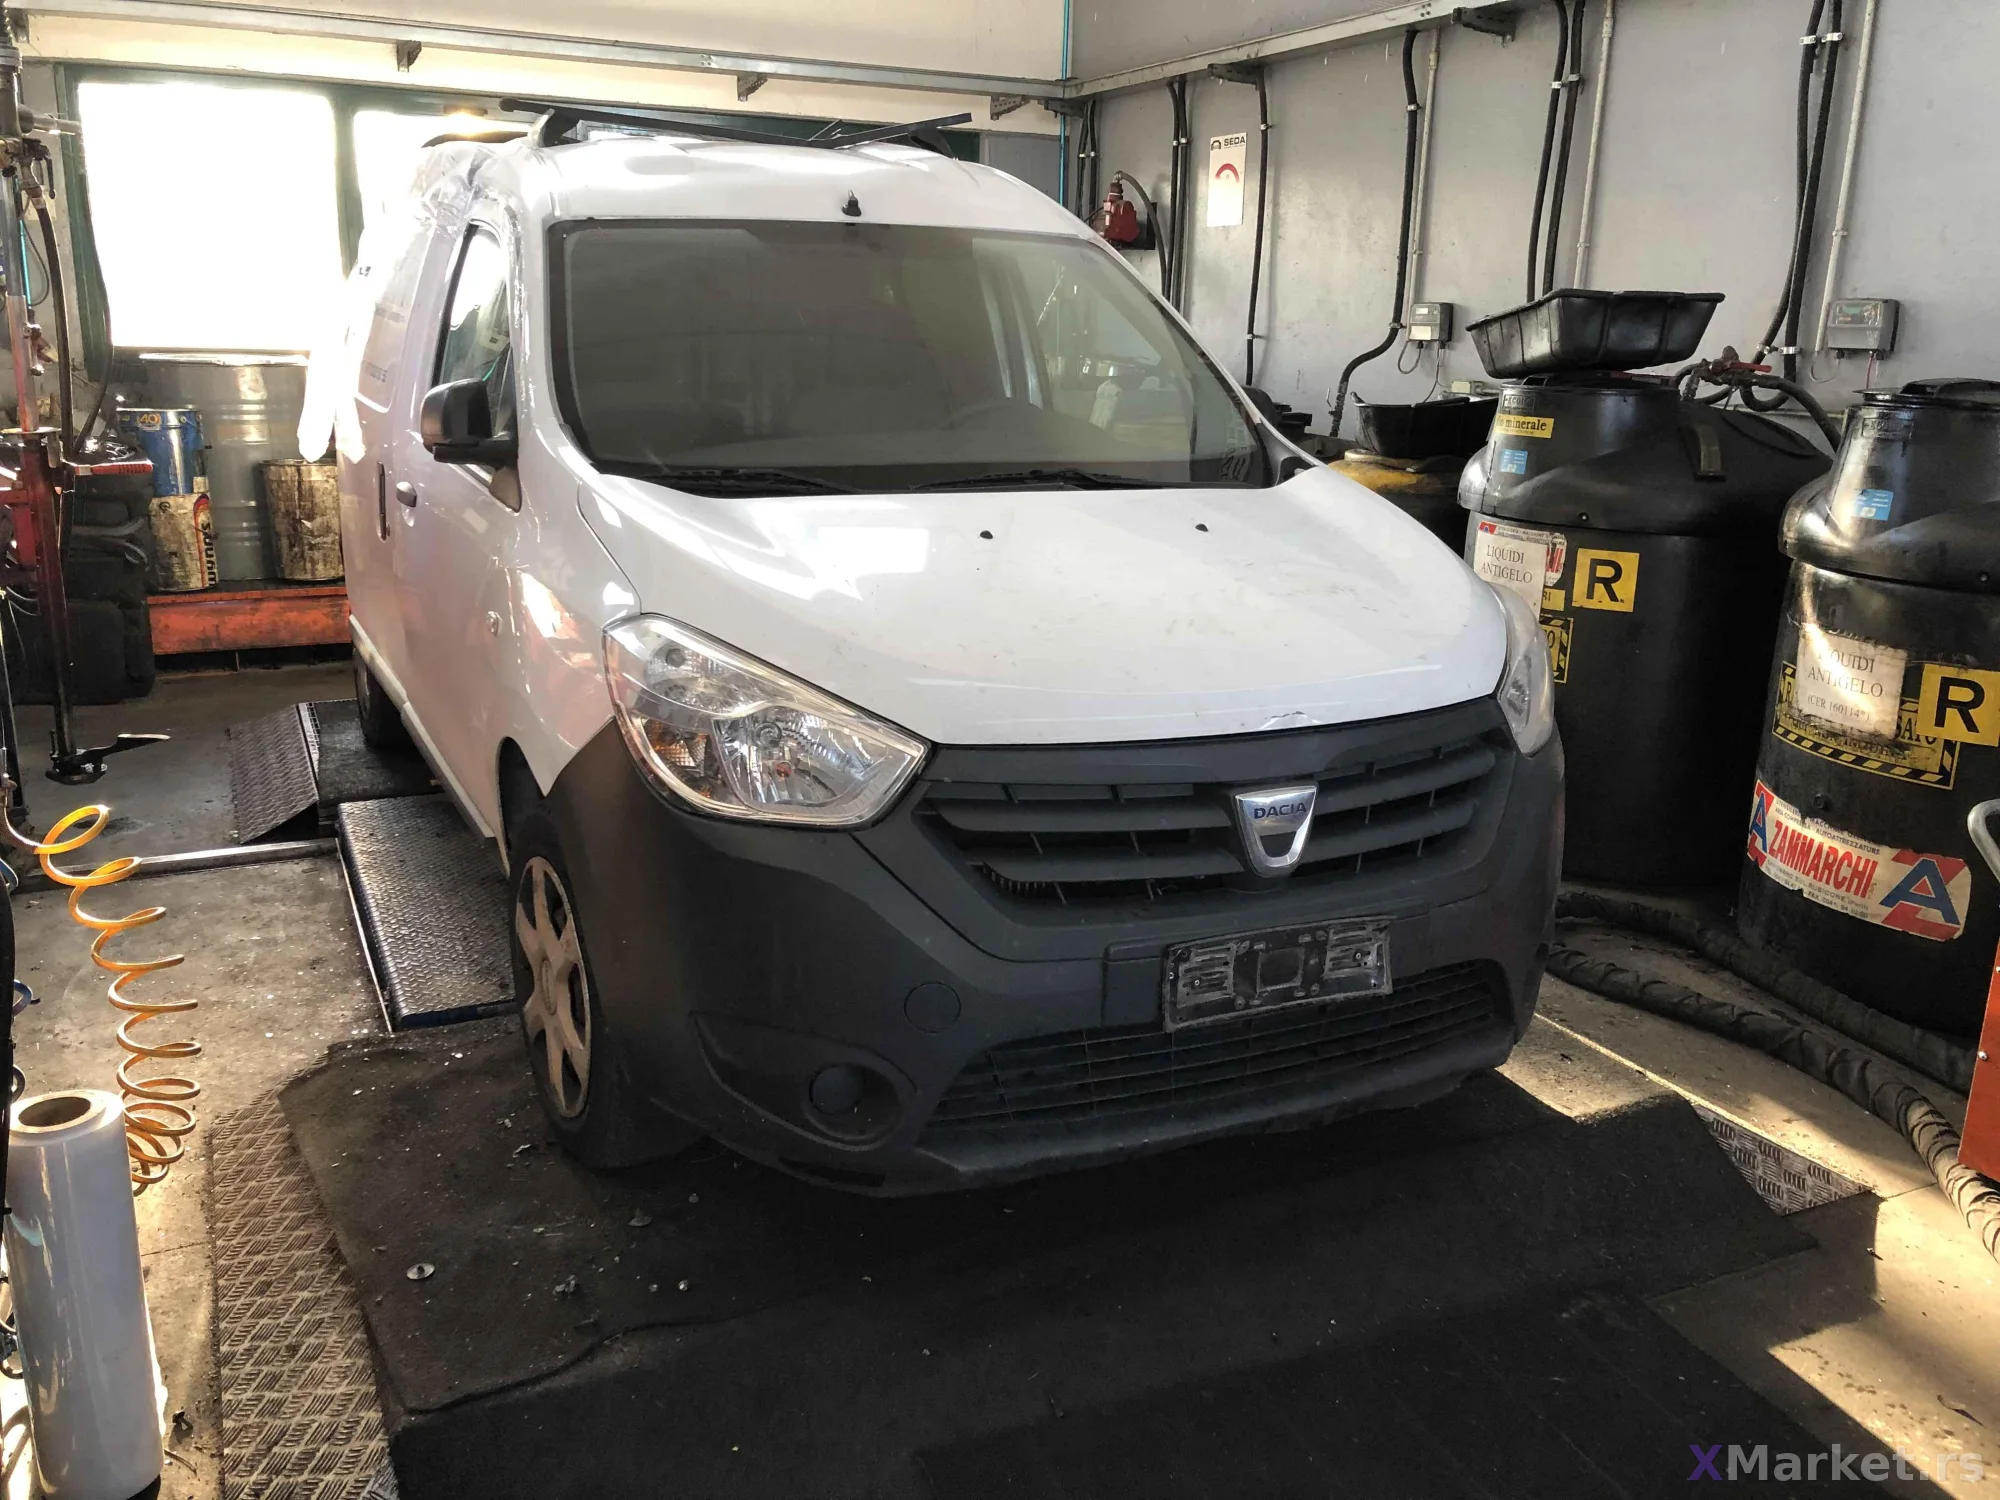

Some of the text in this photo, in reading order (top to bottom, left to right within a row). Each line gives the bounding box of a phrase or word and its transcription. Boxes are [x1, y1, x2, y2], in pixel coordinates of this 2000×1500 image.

[1505, 417, 1547, 431] minerale
[1486, 544, 1525, 564] LIQUIDI
[1481, 561, 1533, 583] ANTIGELO
[1586, 557, 1623, 602] R
[1817, 648, 1875, 673] LQUIDI
[1807, 665, 1883, 698] ANTIGELO
[1934, 676, 1986, 733] R
[1253, 802, 1308, 819] DACIA
[1816, 828, 1880, 855] AUTOATTREZZATURE
[1768, 819, 1879, 899] ZAMMARCHI
